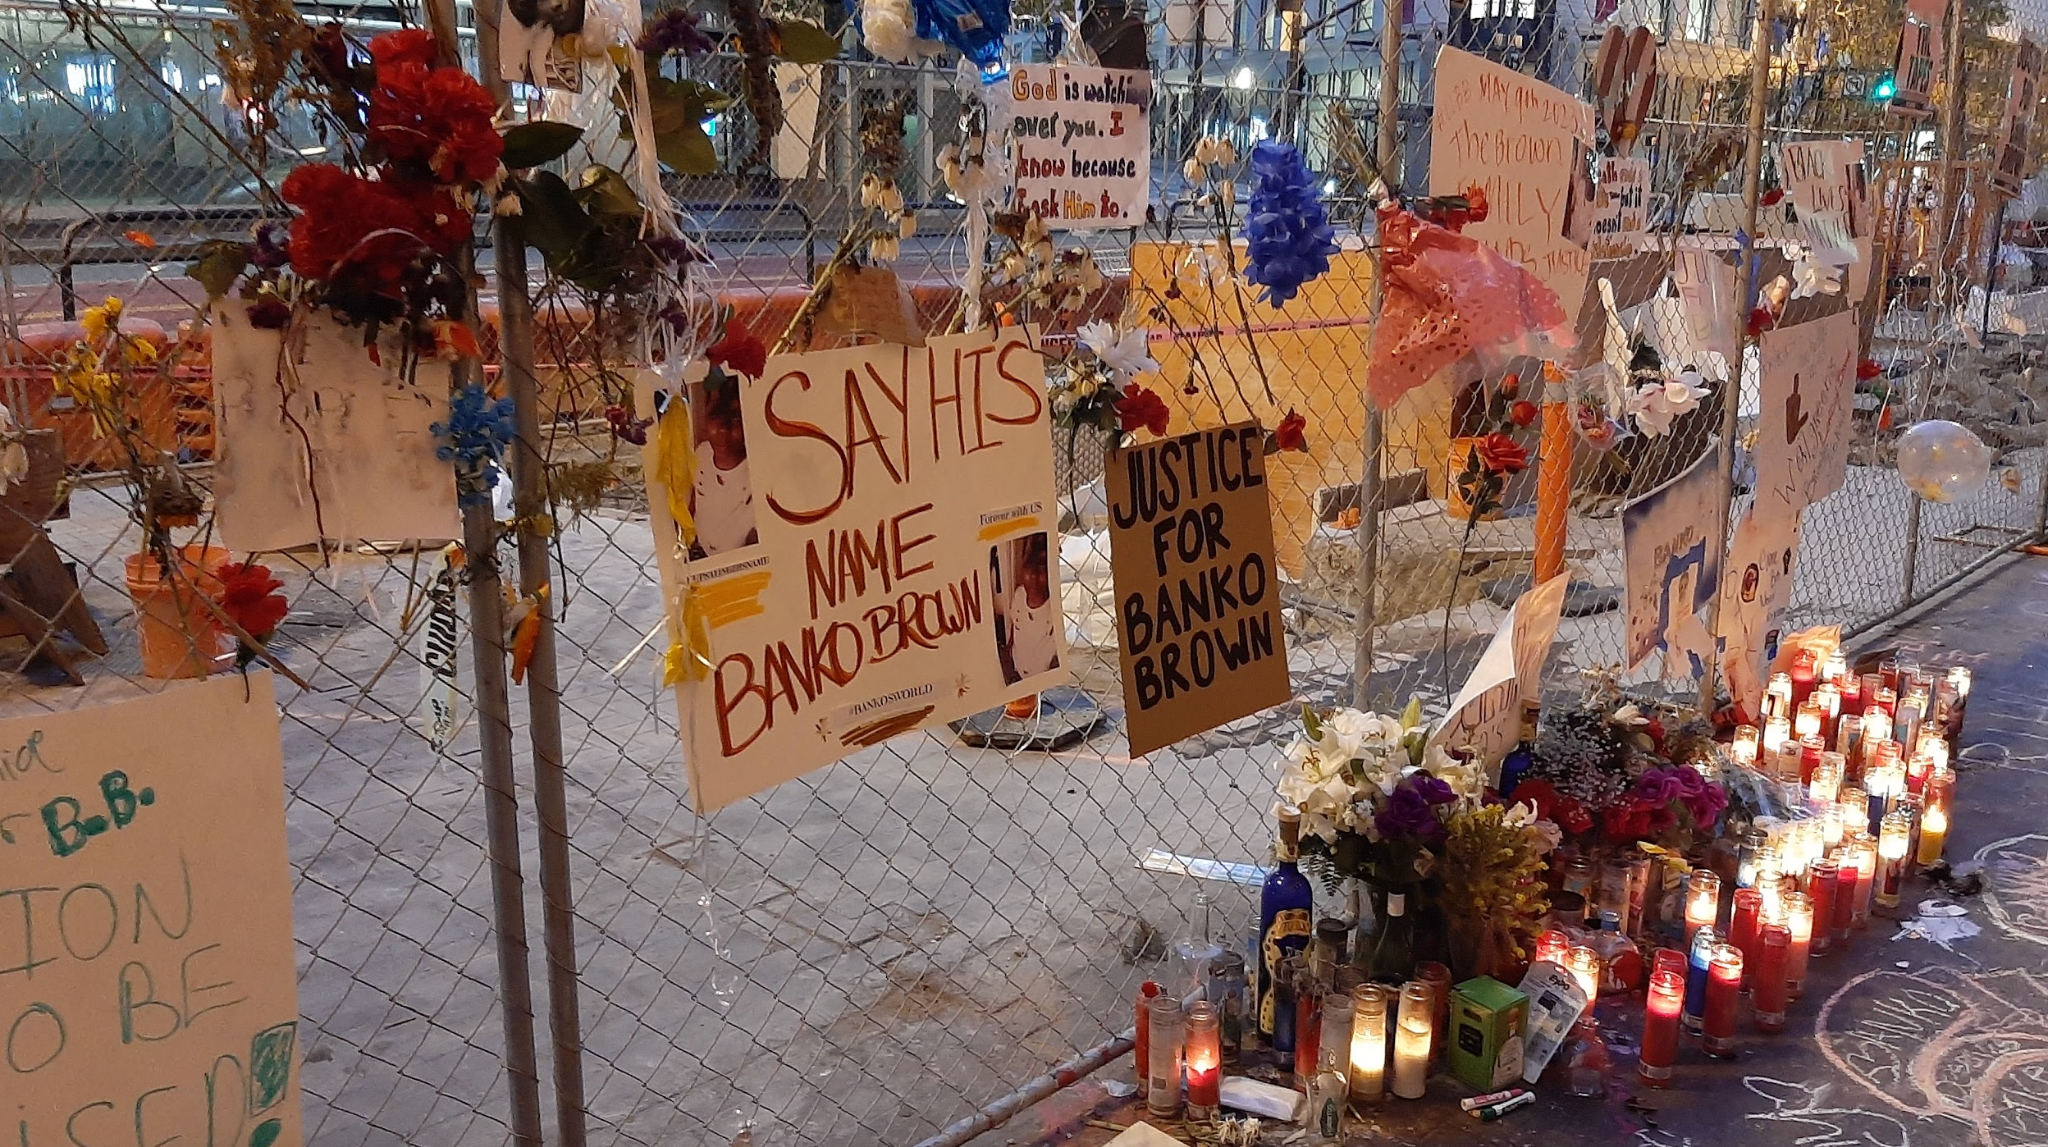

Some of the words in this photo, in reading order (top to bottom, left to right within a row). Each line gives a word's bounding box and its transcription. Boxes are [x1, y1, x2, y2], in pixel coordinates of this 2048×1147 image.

[1012, 68, 1058, 101] God
[1064, 72, 1080, 101] is
[1084, 72, 1148, 106] watchi
[1014, 111, 1059, 139] over
[1062, 119, 1104, 147] you.
[1110, 111, 1125, 137] I
[1479, 72, 1511, 113] MAY
[1017, 144, 1066, 179] know
[1072, 149, 1137, 179] because
[1449, 119, 1490, 168] The
[1494, 129, 1563, 167] Brown
[1031, 188, 1060, 219] ask
[1063, 190, 1096, 220] Him
[1100, 188, 1129, 219] to.
[765, 345, 910, 526] SAY
[928, 340, 1042, 463] HIS
[1113, 426, 1263, 530] JUSTICE
[805, 503, 937, 620] NAME
[1153, 502, 1231, 578] FOR
[1123, 552, 1266, 656] BANKO
[714, 621, 864, 758] BANKO
[862, 569, 982, 664] BROWN
[1133, 611, 1274, 711] BROWN
[118, 944, 249, 1044] BE
